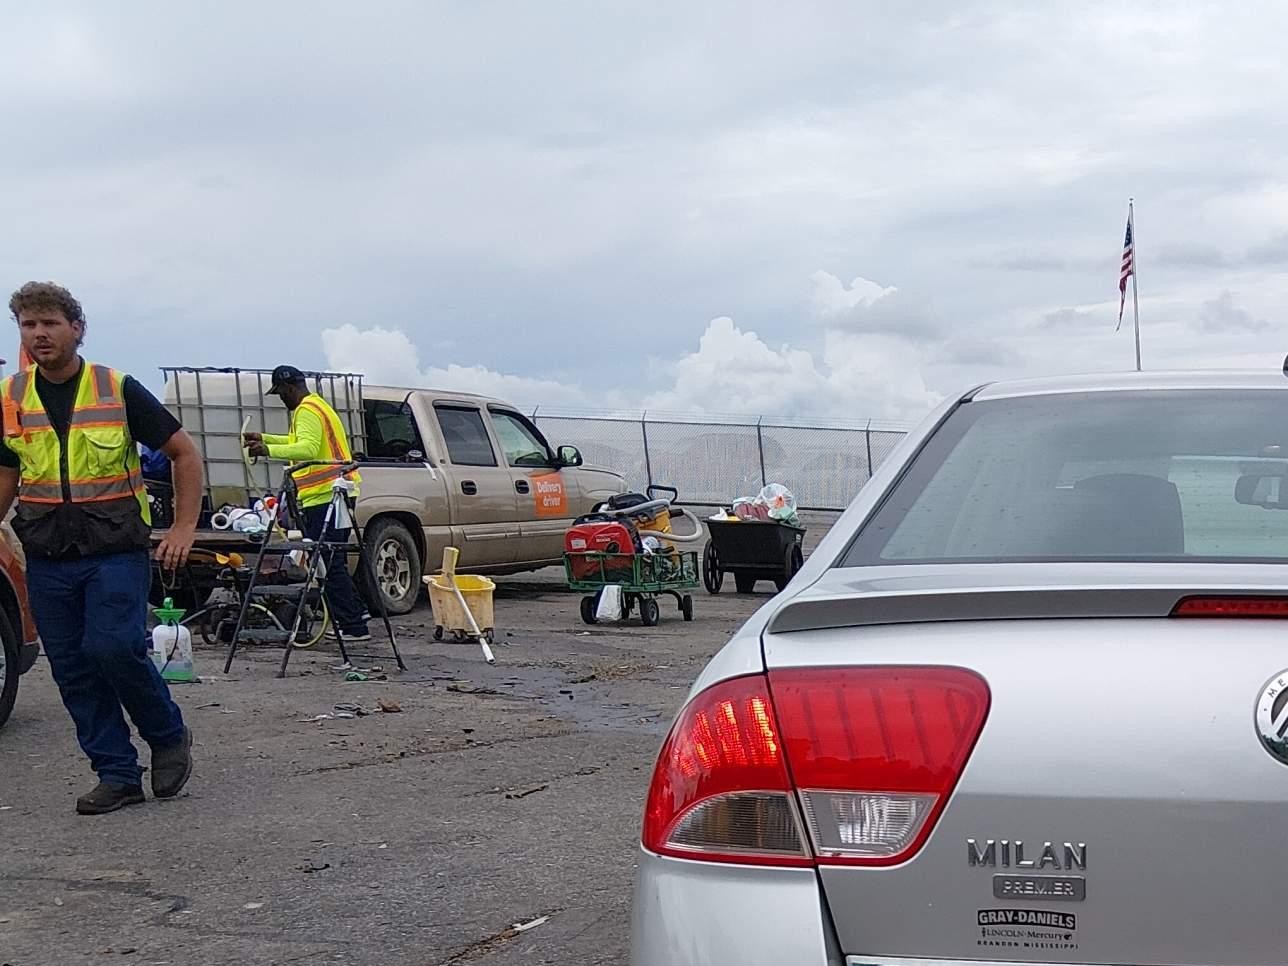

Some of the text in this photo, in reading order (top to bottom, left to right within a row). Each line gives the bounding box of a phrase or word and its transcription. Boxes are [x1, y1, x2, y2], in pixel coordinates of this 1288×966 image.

[967, 839, 1086, 870] MILAN
[1002, 880, 1075, 896] PREMIER
[979, 911, 1074, 928] GRAY-DANIELS
[1023, 942, 1079, 950] MISSISSIPPI
